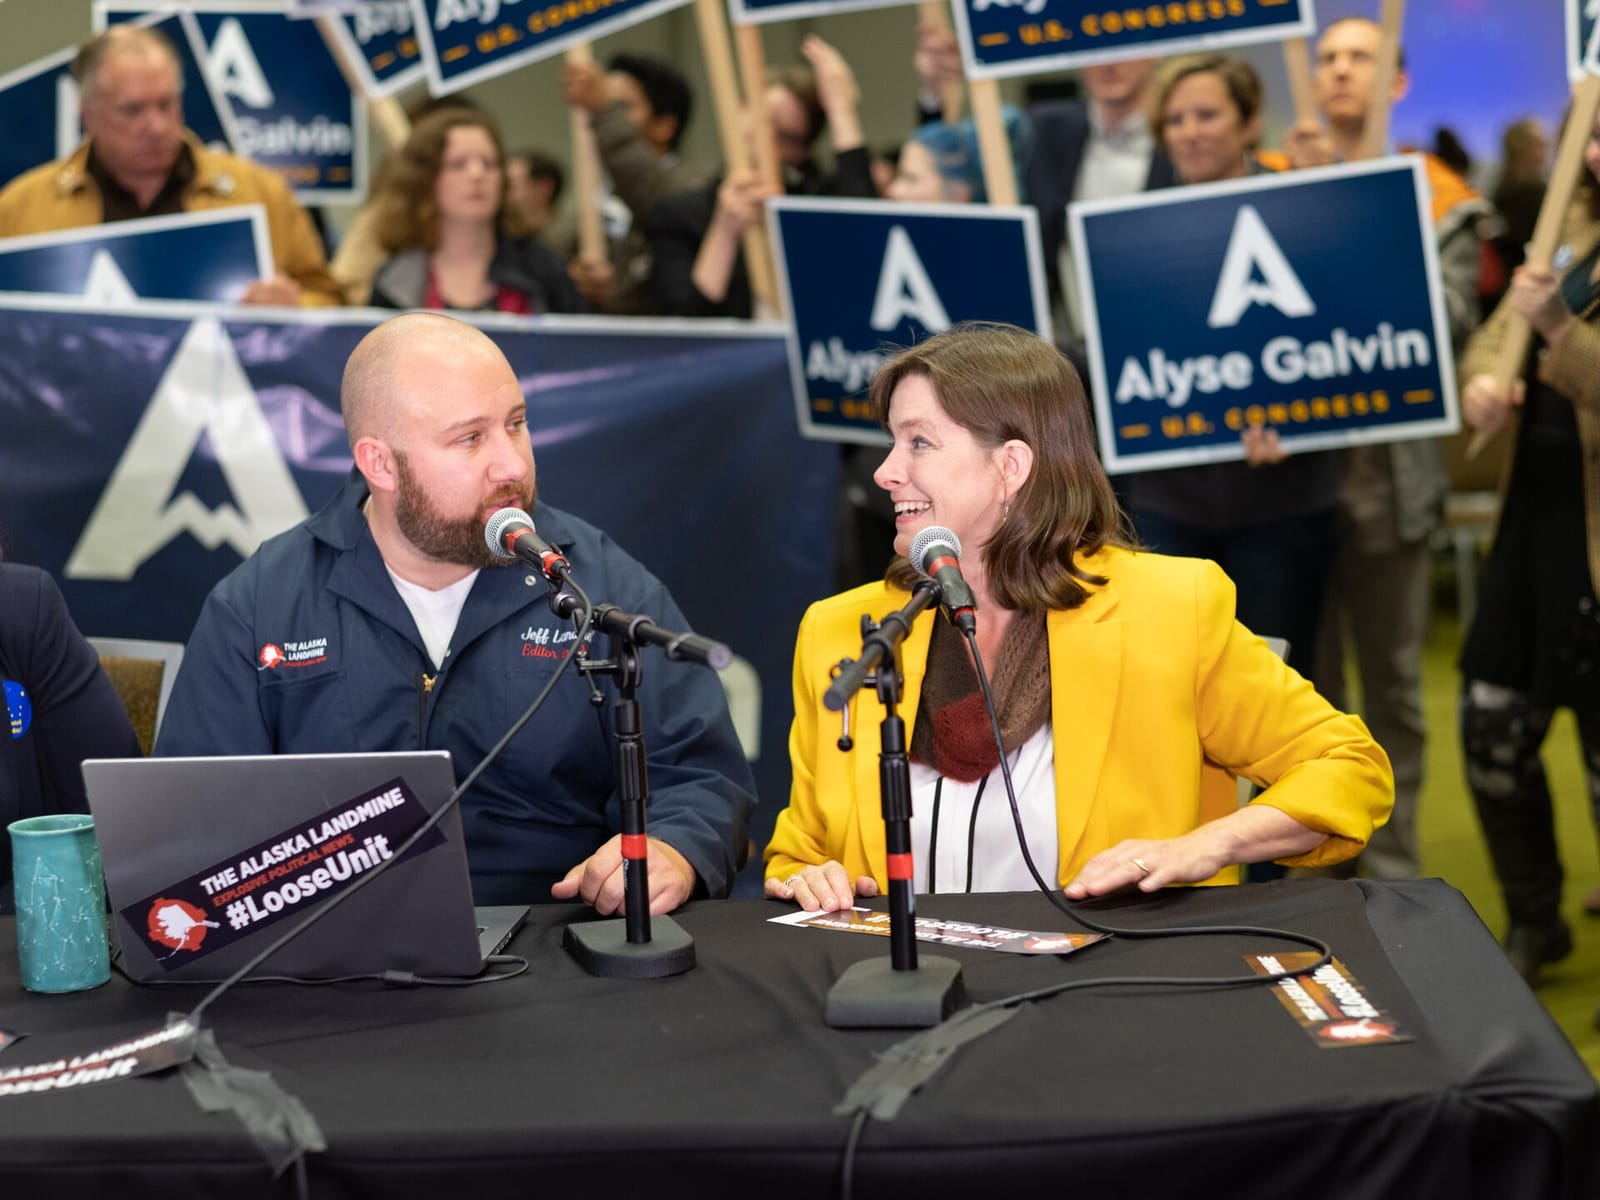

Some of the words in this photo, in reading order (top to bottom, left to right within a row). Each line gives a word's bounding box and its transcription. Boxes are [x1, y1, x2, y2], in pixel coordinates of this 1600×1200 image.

[806, 336, 880, 393] Alys
[1114, 347, 1254, 408] Alyse
[1261, 320, 1432, 384] Galvin
[1160, 411, 1216, 439] U.S.
[1223, 389, 1391, 431] CONGRESS
[520, 626, 550, 645] Jeff
[521, 643, 558, 660] Editor
[199, 866, 240, 896] THE
[240, 834, 311, 880] ALASKA
[308, 786, 406, 845] LANDMINE
[212, 873, 269, 908] EXPLOSIVE
[268, 850, 323, 879] POLITICAL
[320, 833, 355, 857] NEWS
[225, 833, 394, 931] #LooseUnit
